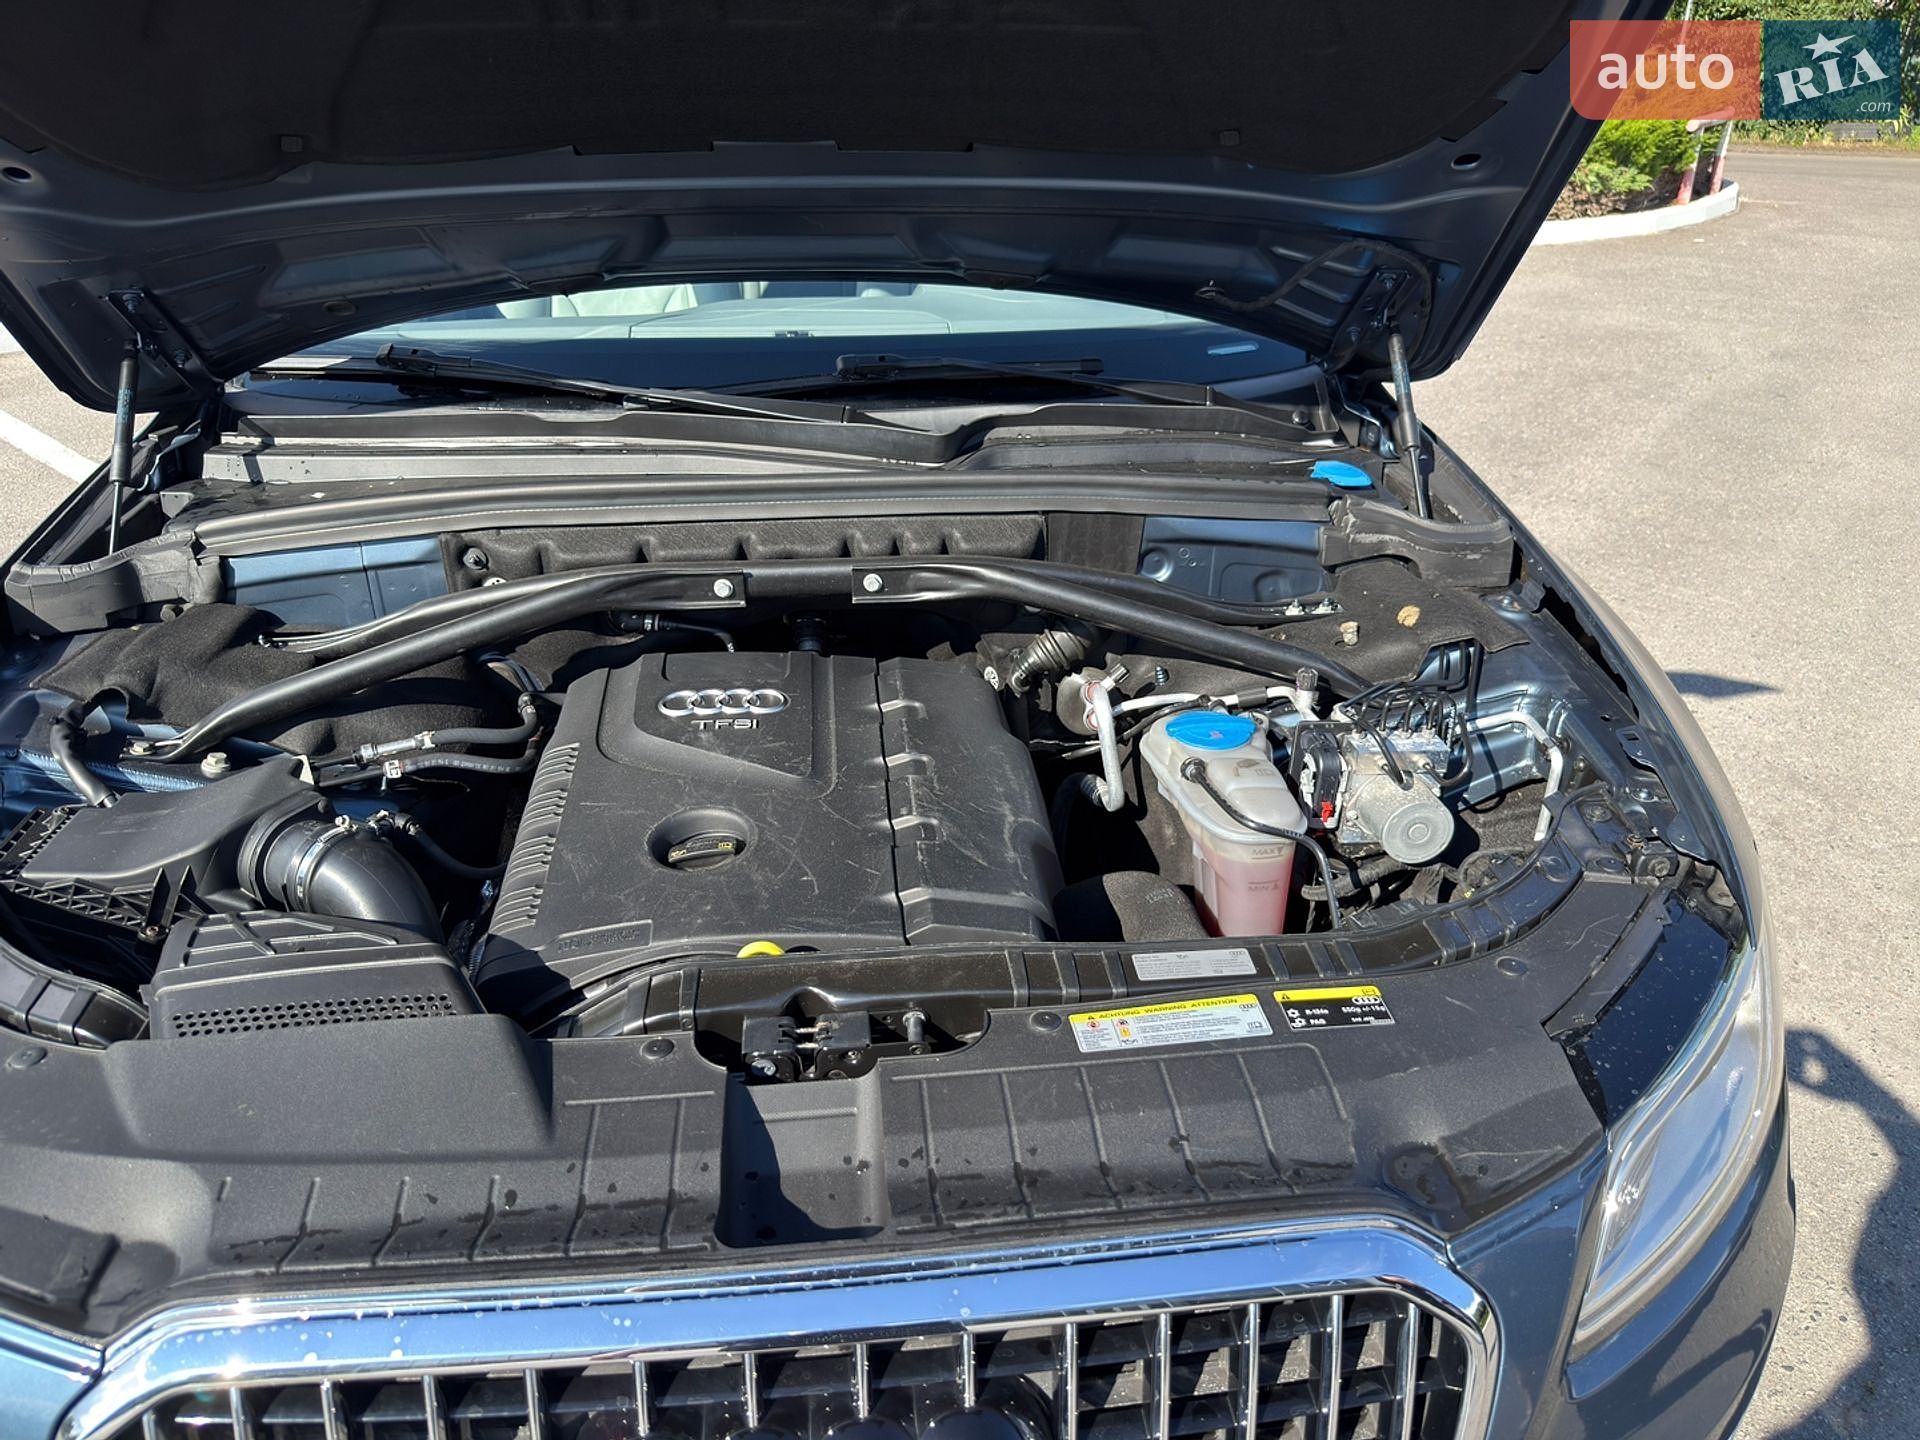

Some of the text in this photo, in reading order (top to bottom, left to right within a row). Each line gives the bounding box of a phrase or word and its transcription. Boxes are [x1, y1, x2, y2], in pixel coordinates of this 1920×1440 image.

[691, 719, 758, 730] TFSI
[1099, 998, 1238, 1019] ACHTUNG WARNING ATTENTION
